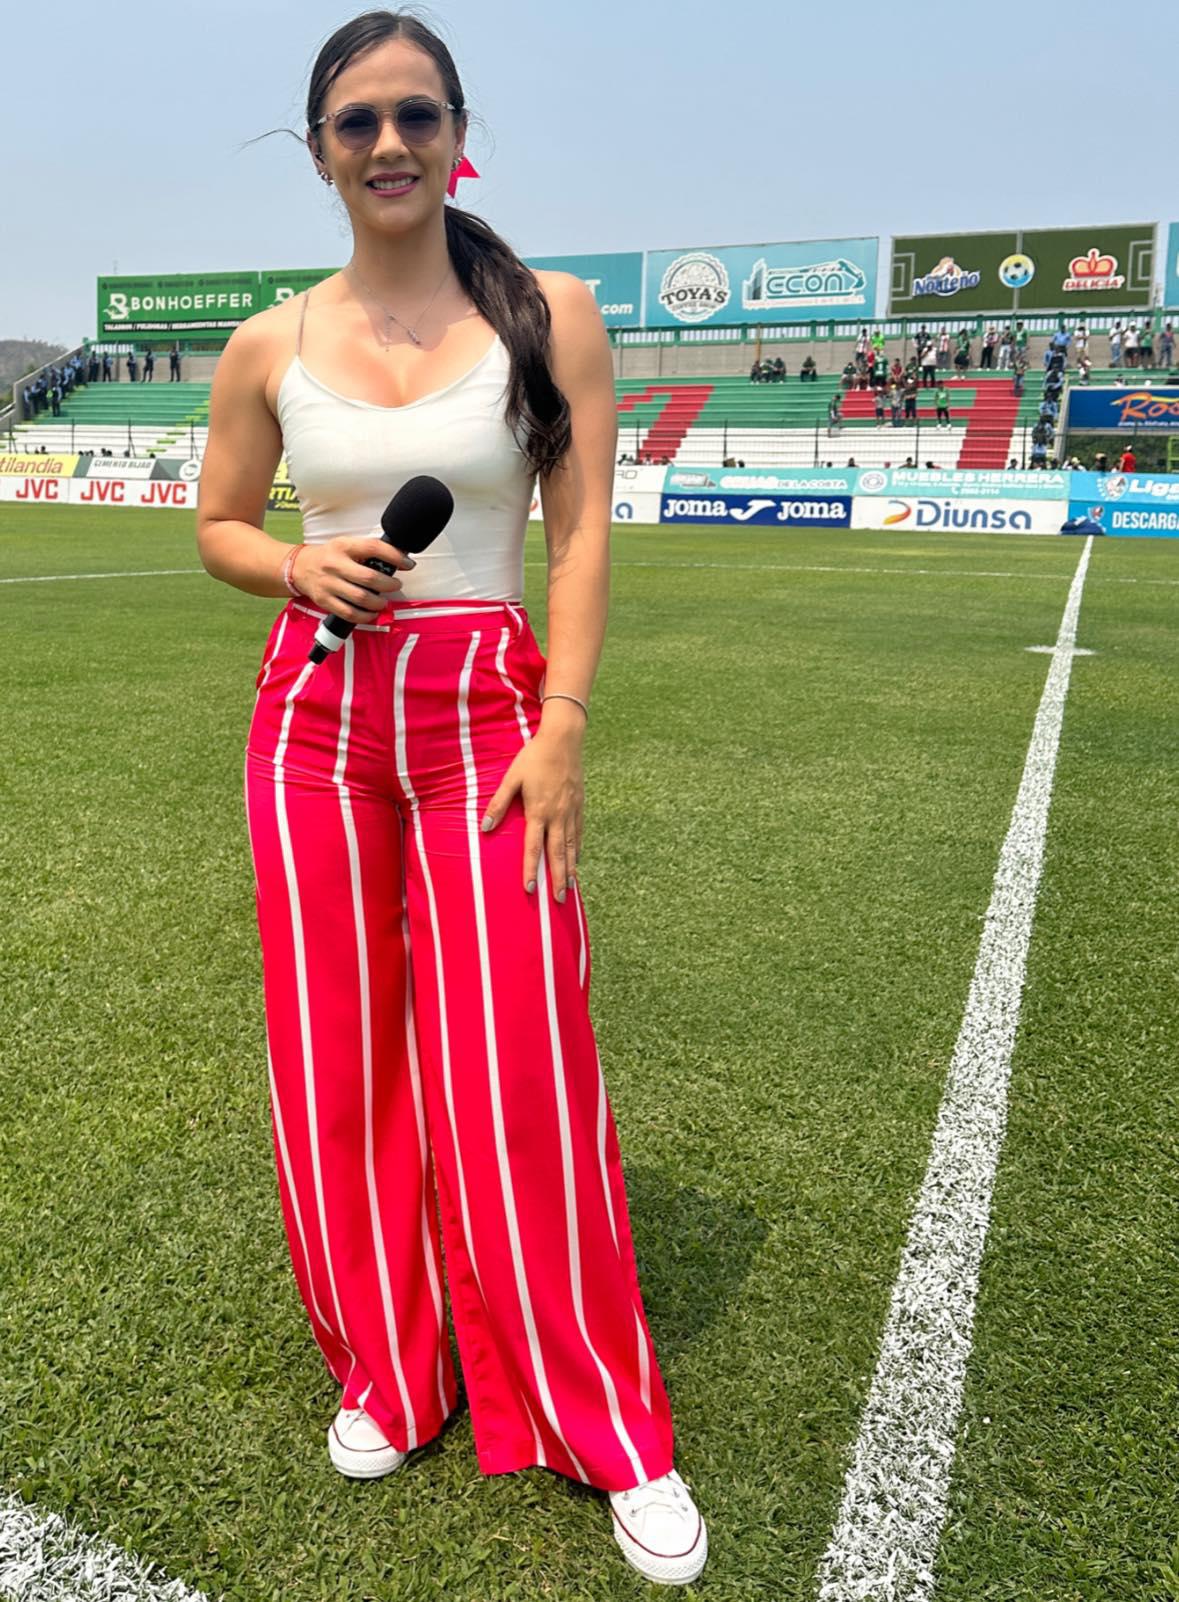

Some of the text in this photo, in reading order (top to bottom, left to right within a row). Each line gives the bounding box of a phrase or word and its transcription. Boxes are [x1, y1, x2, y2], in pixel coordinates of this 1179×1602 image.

[131, 293, 253, 310] BONHOEFFER
[661, 287, 728, 305] TOYA'S
[892, 471, 1065, 484] MUEBLES HERRERA
[16, 479, 59, 499] JVC
[80, 480, 125, 502] JVC
[141, 482, 187, 504] JVC
[916, 500, 1032, 530] Diunsa
[1112, 511, 1179, 529] DESCARG
